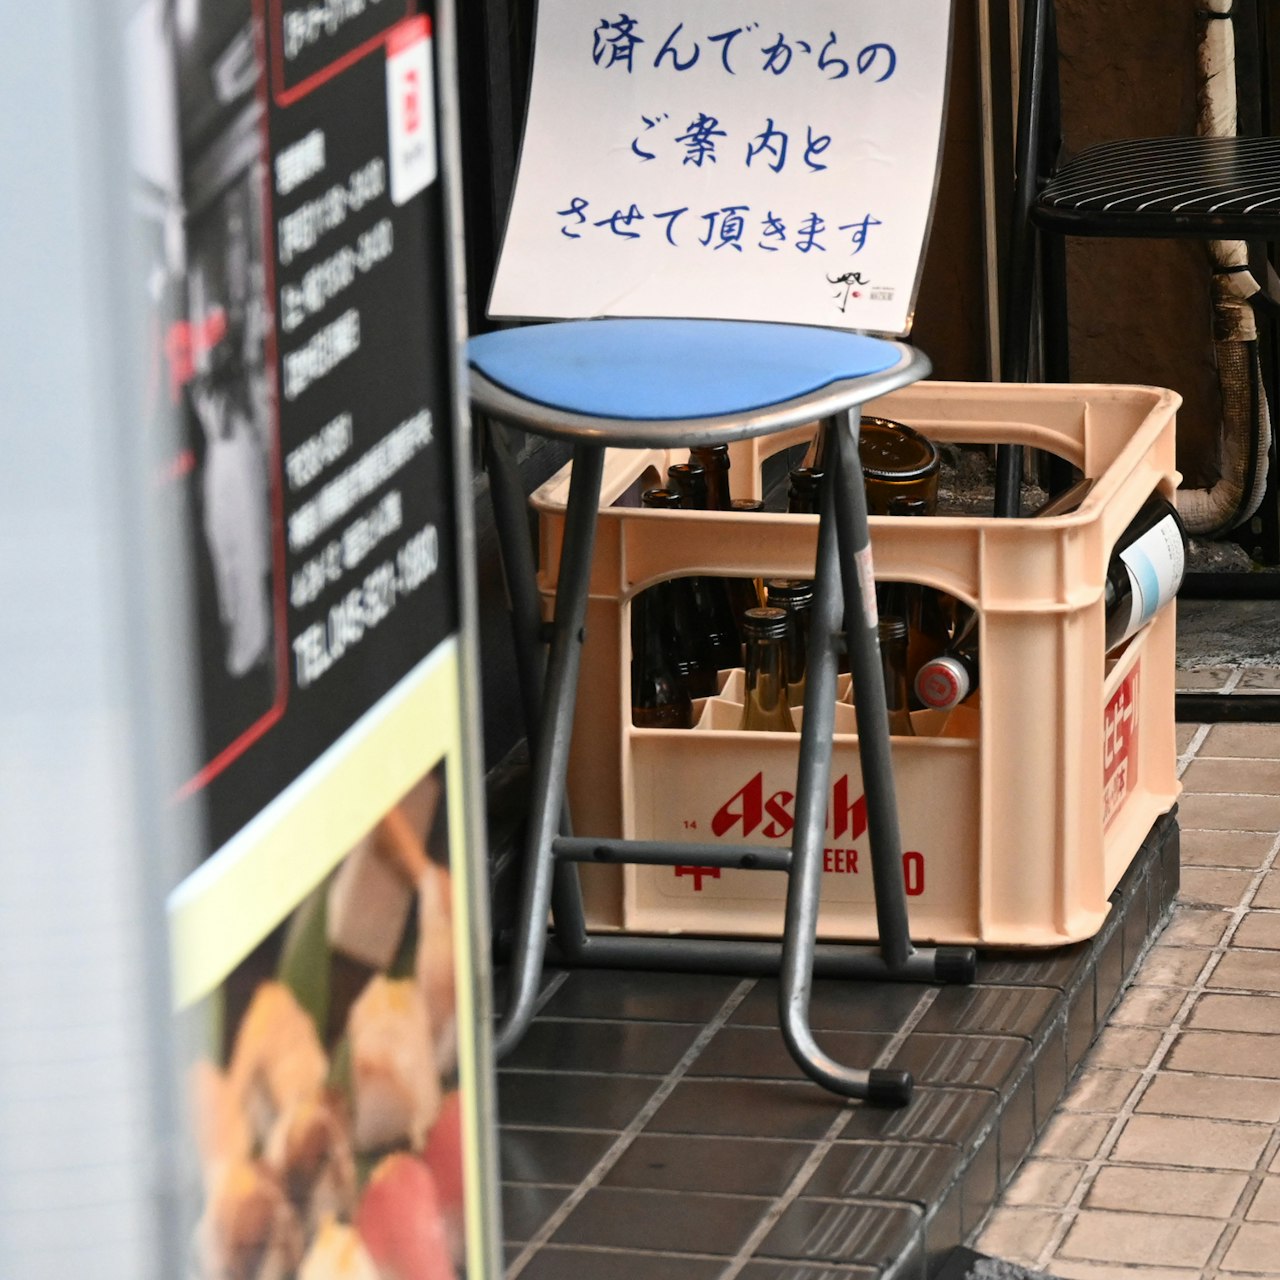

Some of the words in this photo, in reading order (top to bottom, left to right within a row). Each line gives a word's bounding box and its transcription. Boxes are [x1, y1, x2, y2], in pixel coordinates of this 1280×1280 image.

[591, 12, 897, 84] 済んでからの
[630, 111, 833, 175] ご案内と
[555, 196, 882, 257] させて頂きます
[683, 820, 697, 830] 14
[711, 771, 869, 841] Ash
[823, 848, 859, 874] EER
